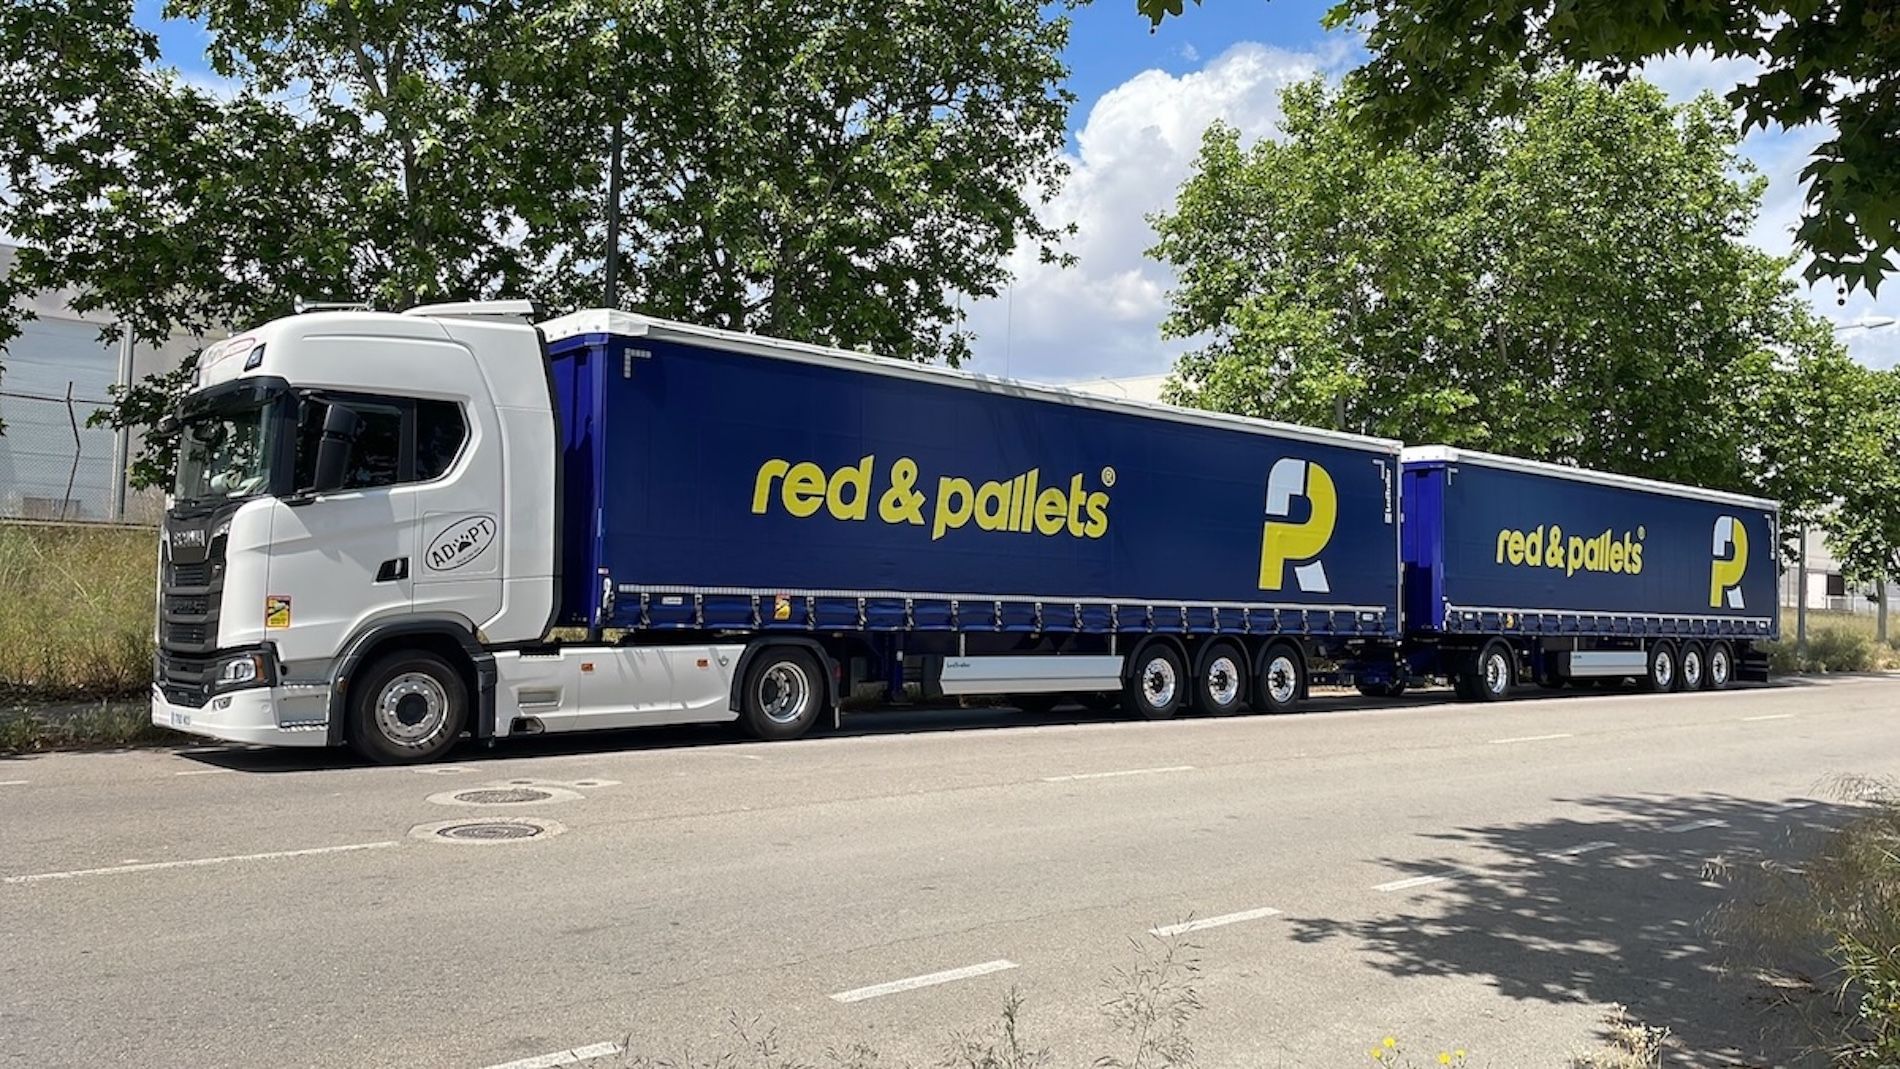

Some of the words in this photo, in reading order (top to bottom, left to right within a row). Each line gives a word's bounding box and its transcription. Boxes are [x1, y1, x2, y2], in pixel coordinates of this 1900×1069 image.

[751, 454, 875, 521] red
[878, 456, 926, 526] &
[1496, 524, 1545, 567] red
[1544, 524, 1566, 569] &
